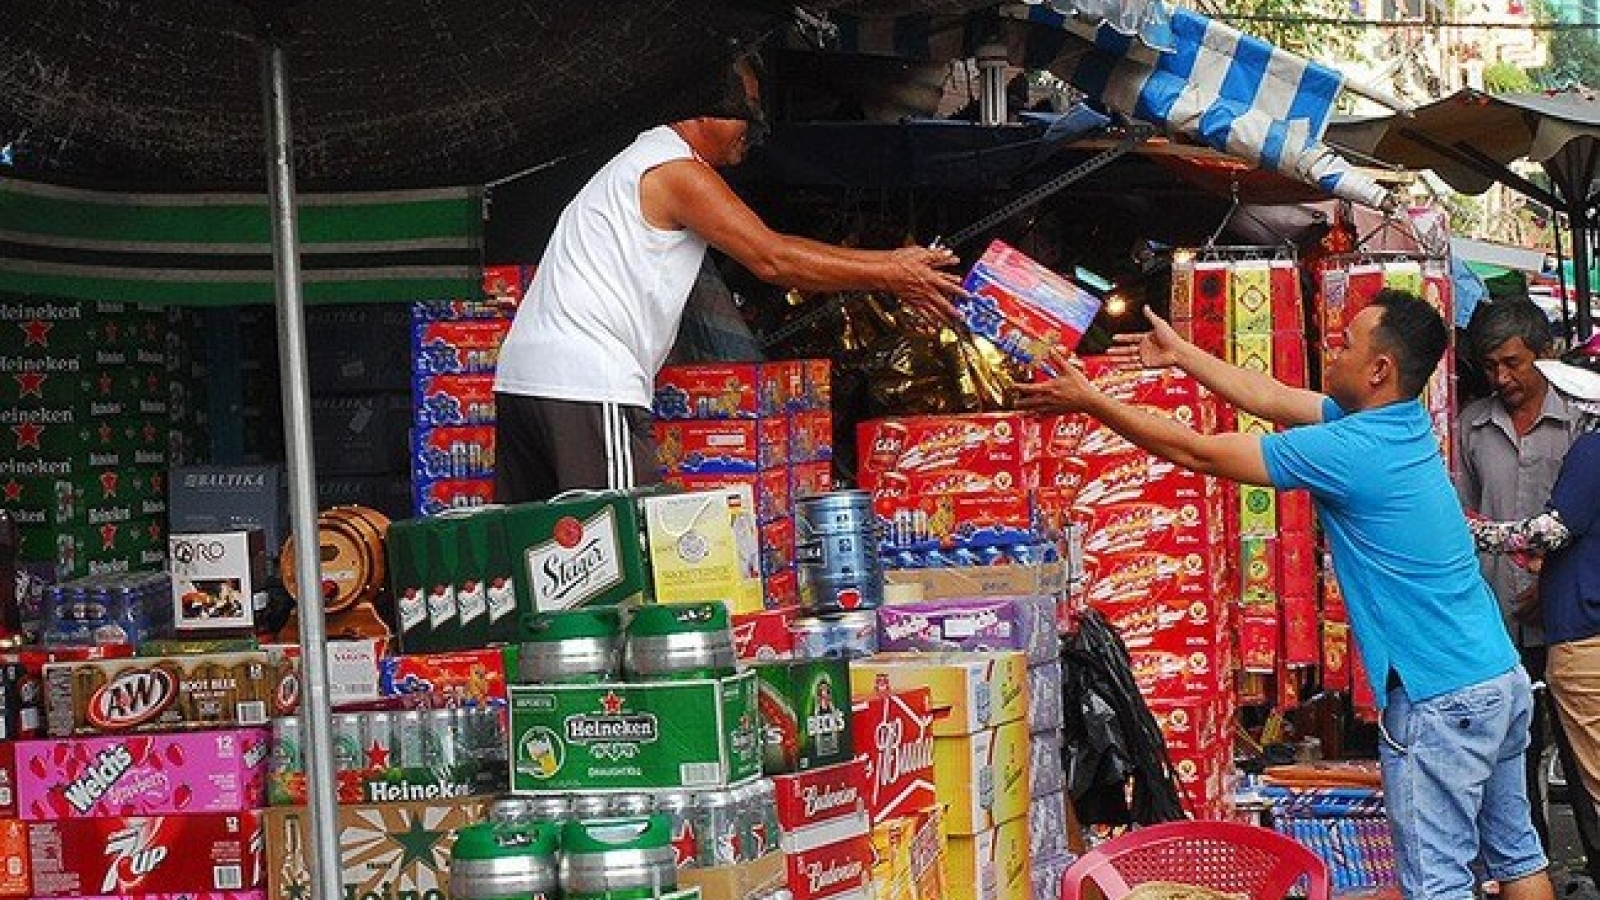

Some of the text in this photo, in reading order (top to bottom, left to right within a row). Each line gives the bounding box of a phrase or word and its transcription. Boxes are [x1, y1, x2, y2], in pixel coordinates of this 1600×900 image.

[0, 405, 75, 423] eineken
[0, 457, 72, 473] eineken
[543, 544, 605, 597] Steiger
[570, 720, 653, 737] Heineken
